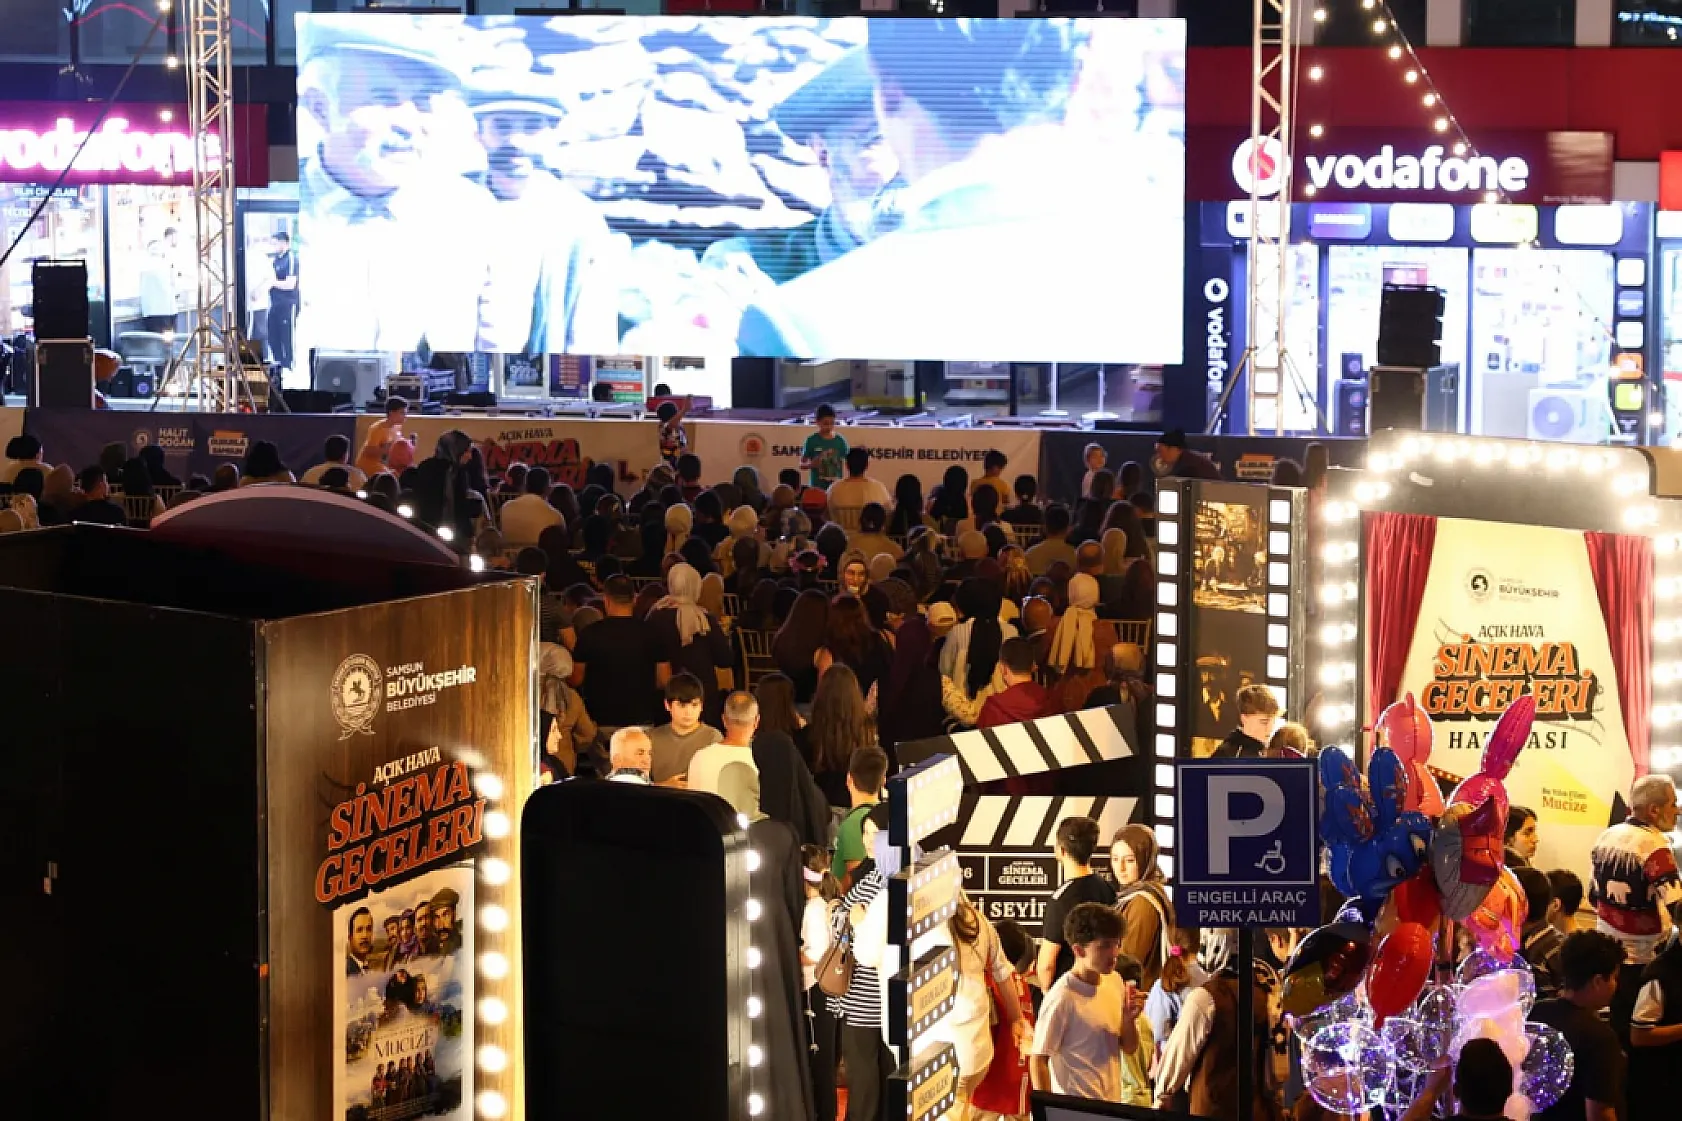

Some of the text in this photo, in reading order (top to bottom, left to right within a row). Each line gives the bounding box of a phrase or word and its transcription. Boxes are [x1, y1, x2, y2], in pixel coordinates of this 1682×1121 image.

[1306, 145, 1529, 191] vodafone
[1479, 625, 1545, 641] AÇIK HAVA
[1434, 633, 1577, 677] SİNEMA
[386, 661, 424, 678] SAMSUN
[386, 664, 477, 698] BÜYÜKŞEHİR
[386, 692, 436, 712] BELEDİYESİ
[1449, 731, 1567, 750] HAASI
[373, 745, 442, 787] AÇIK HAVA
[328, 760, 472, 851] SİNEMA
[1208, 775, 1286, 875] P
[1002, 864, 1044, 875] SİNEMA
[1187, 888, 1307, 907] ENGELLİ ARAÇ
[1199, 909, 1296, 923] PARK ALANI
